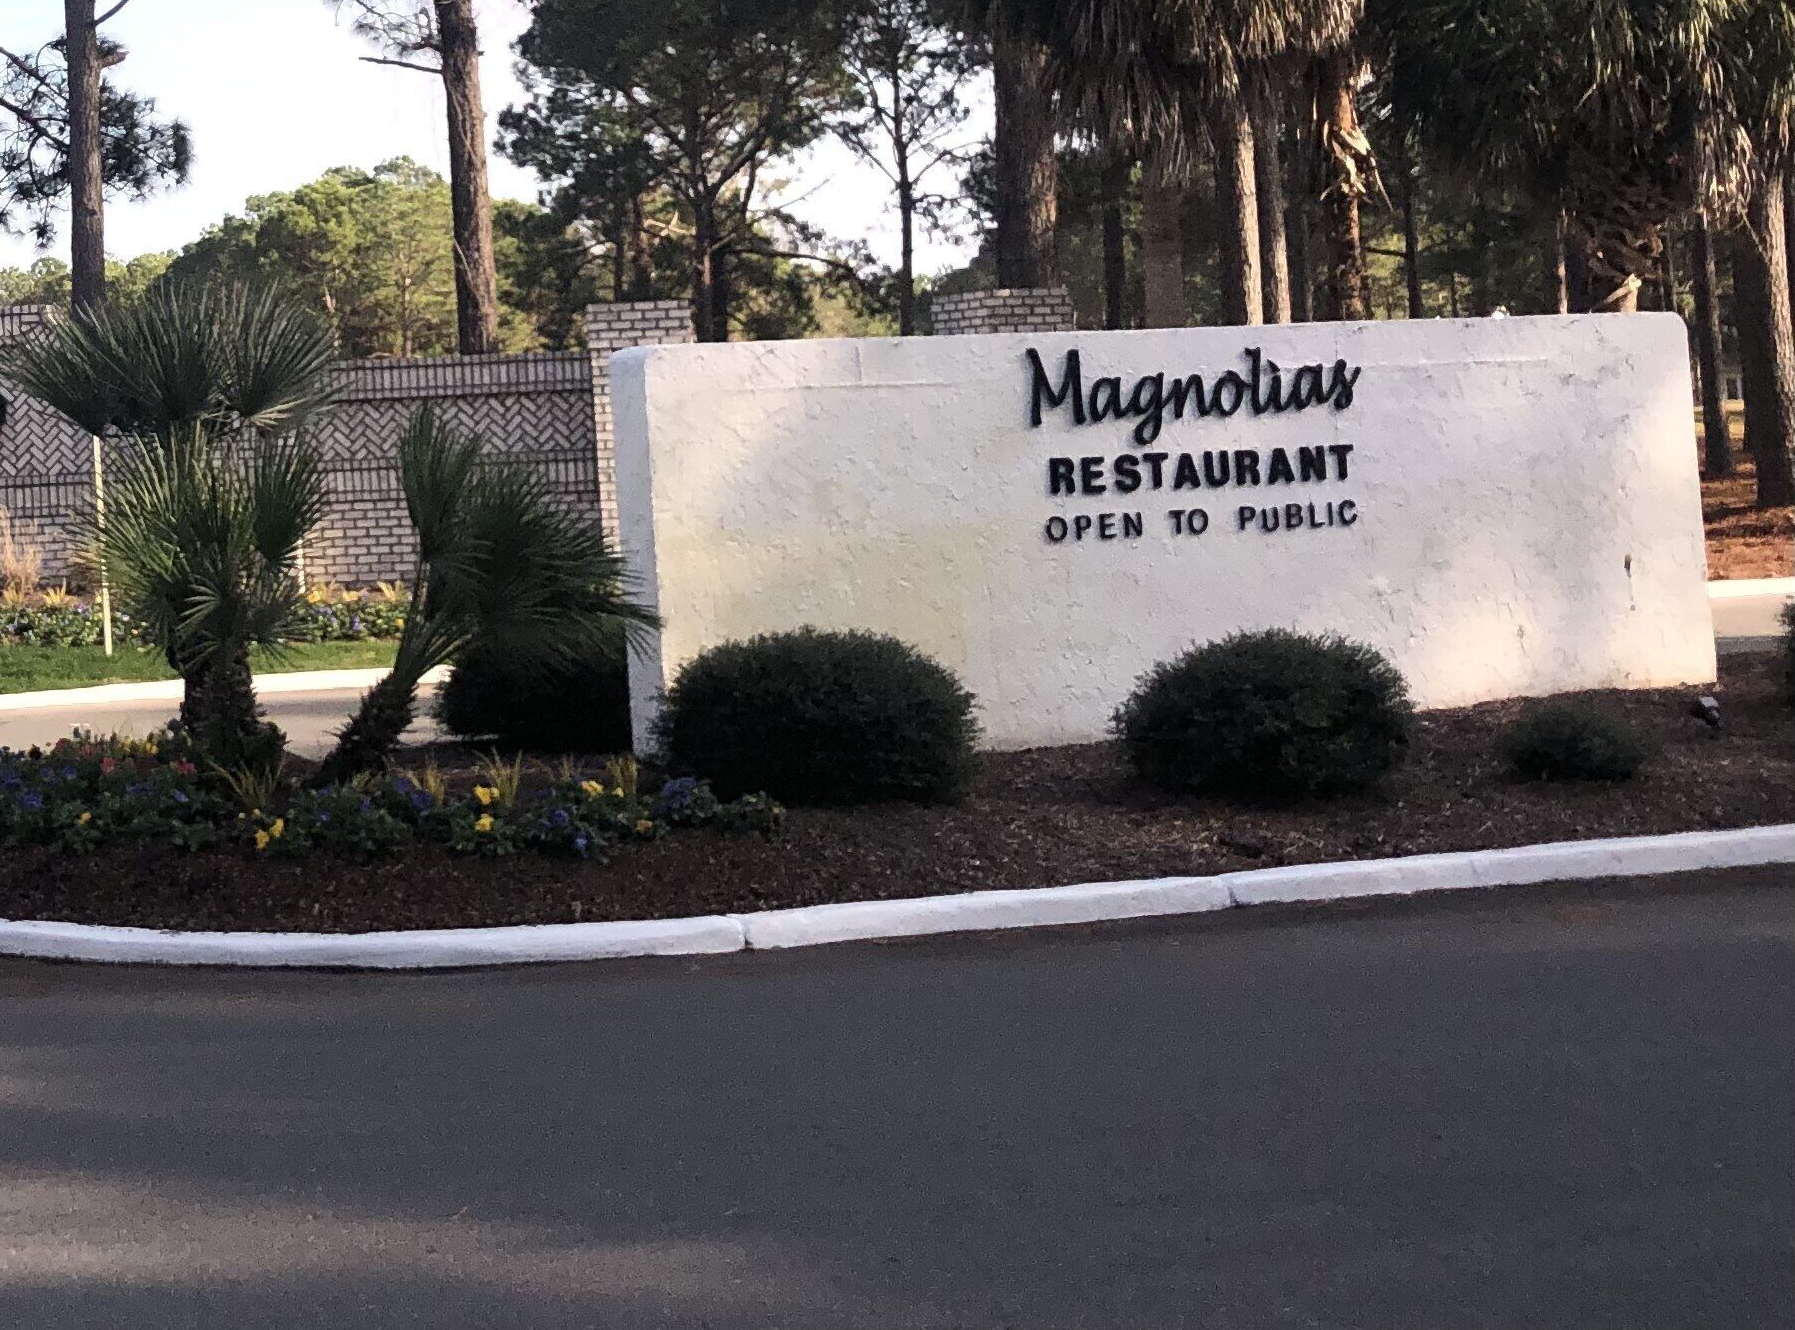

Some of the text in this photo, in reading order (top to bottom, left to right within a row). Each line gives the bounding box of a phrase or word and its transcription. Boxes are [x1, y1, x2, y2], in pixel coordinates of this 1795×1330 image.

[1025, 346, 1361, 444] Magnolias
[1048, 443, 1354, 495] RESTAURANT
[1045, 499, 1358, 542] OPEN TO PUBLIC
